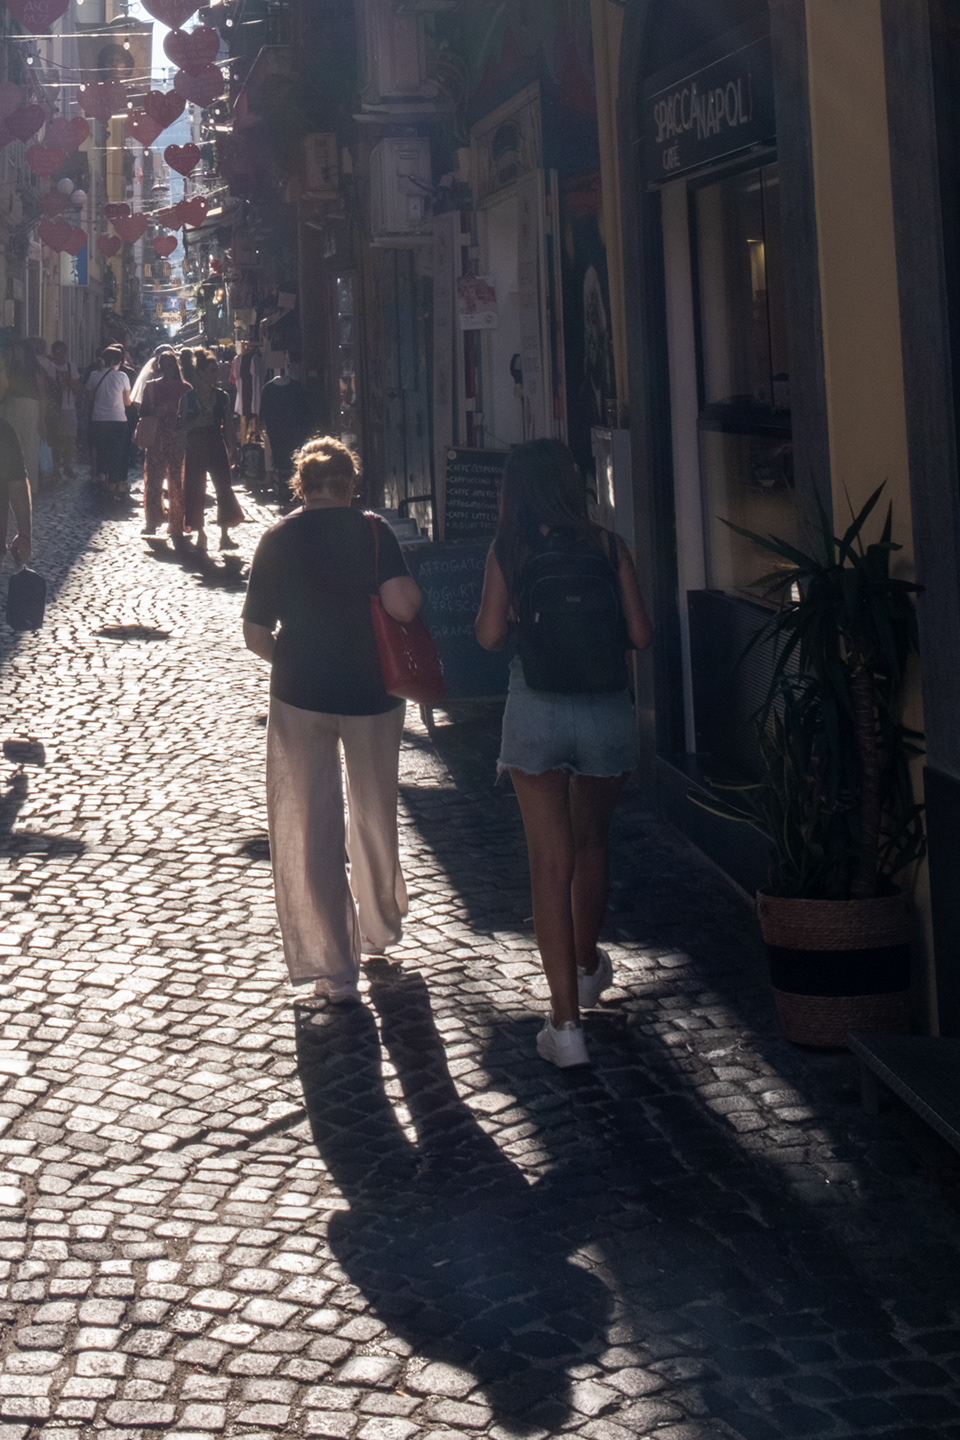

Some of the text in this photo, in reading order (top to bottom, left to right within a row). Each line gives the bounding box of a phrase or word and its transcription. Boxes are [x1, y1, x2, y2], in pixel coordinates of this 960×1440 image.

[449, 476, 491, 485] CAPPUCCINO
[418, 558, 485, 579] AFFOGATO
[423, 582, 478, 602] YOGURT
[431, 600, 481, 612] FRESCO
